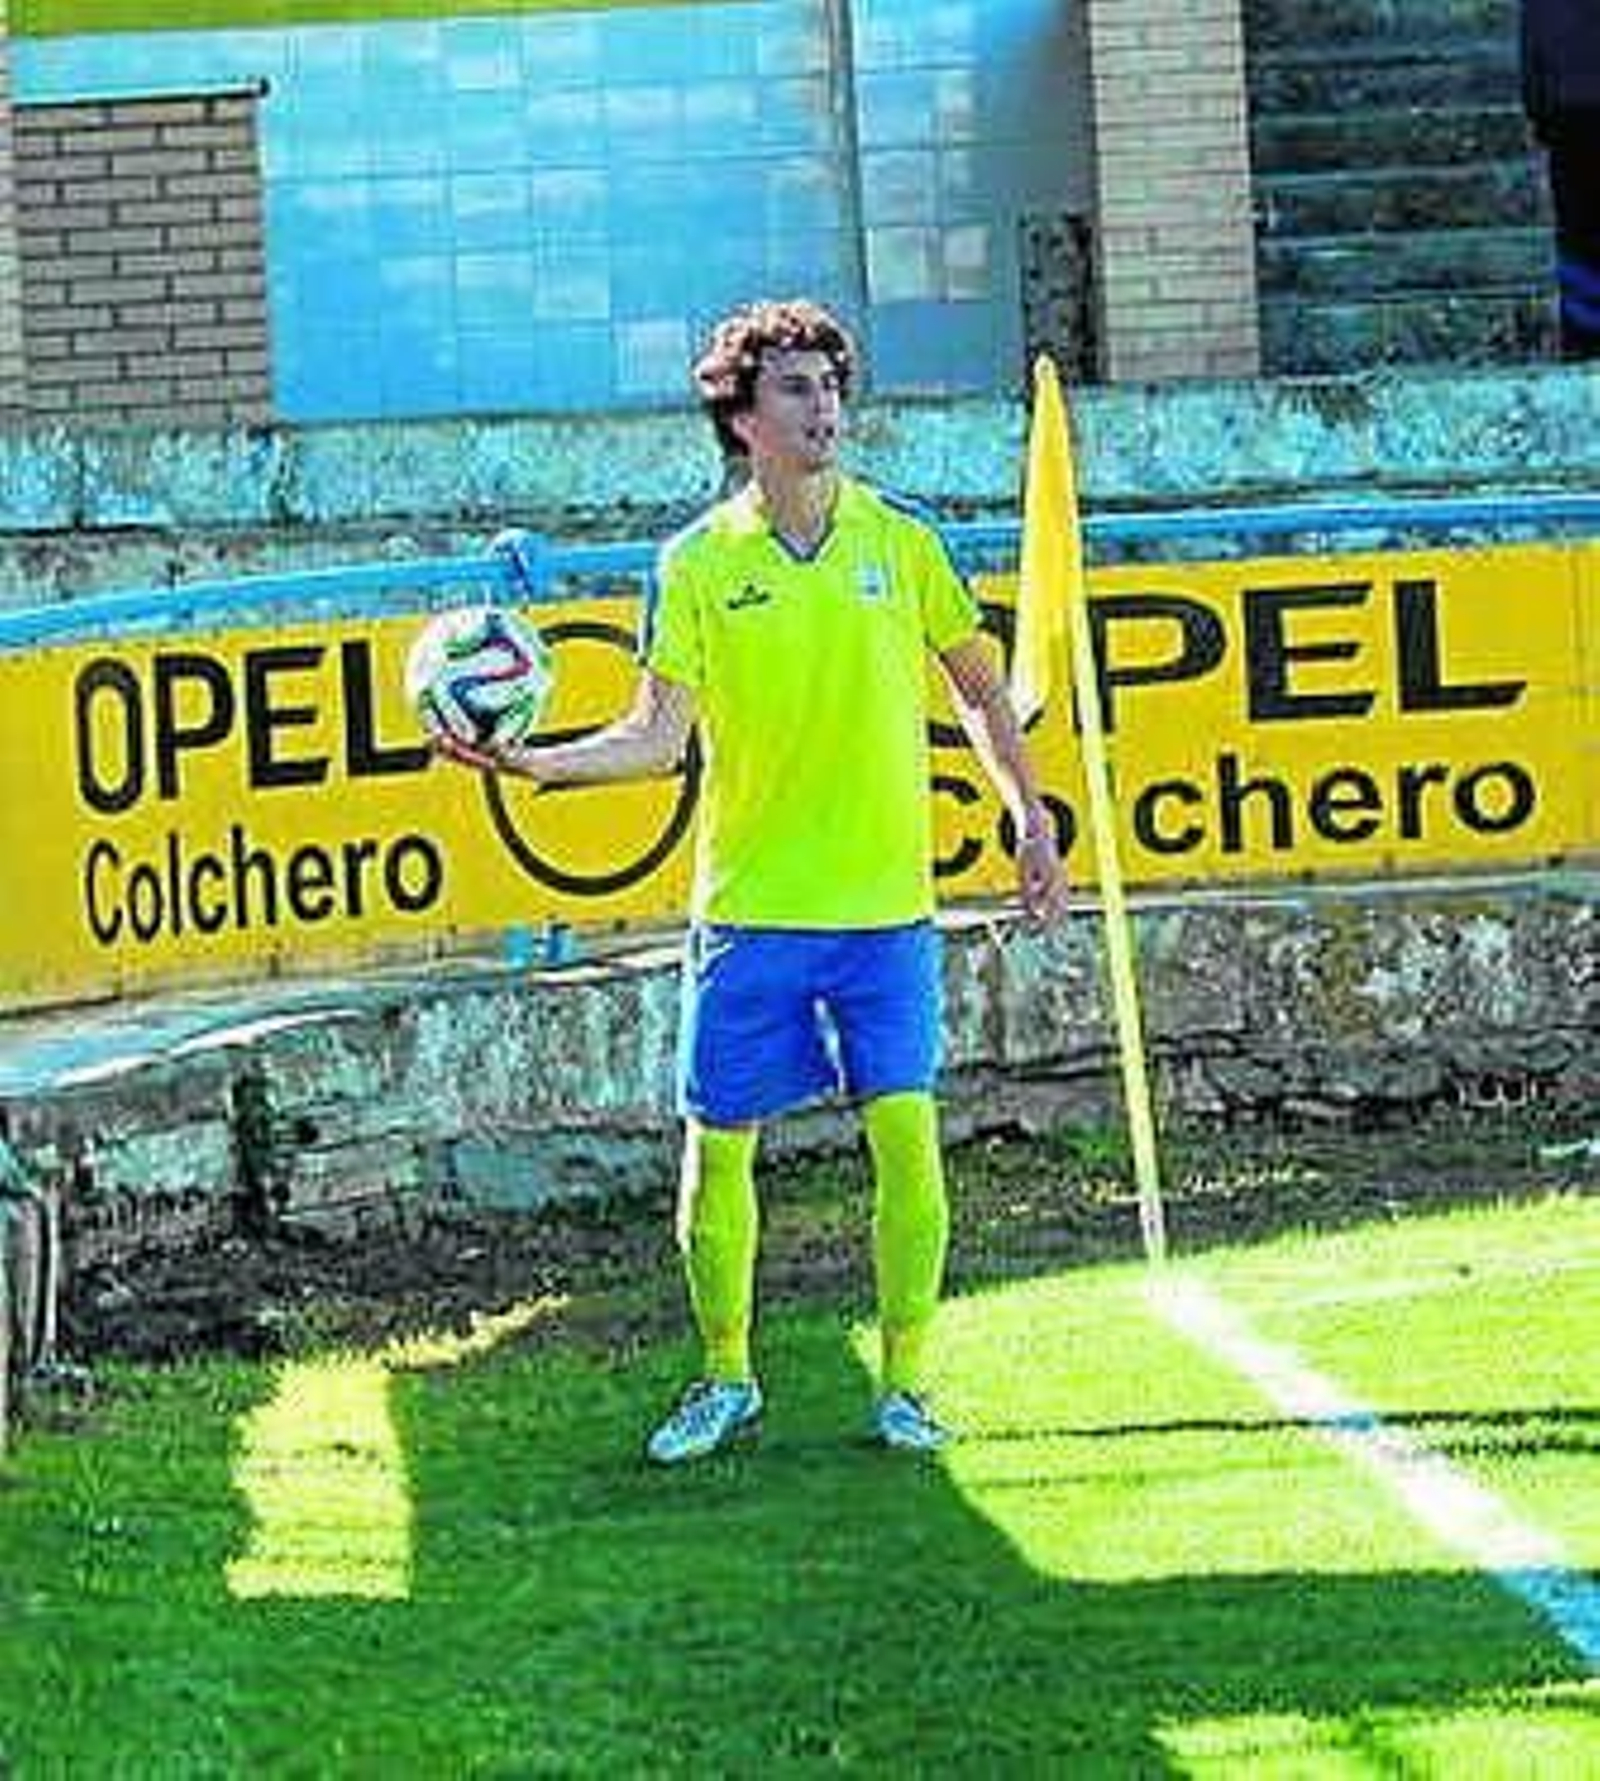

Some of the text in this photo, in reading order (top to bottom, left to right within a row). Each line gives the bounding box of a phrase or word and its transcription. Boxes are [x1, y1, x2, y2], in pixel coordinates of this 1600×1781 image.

[75, 639, 434, 814] OPEL
[928, 579, 1527, 749] PEL
[85, 824, 443, 946] Colchero
[931, 753, 1536, 879] Cochero
